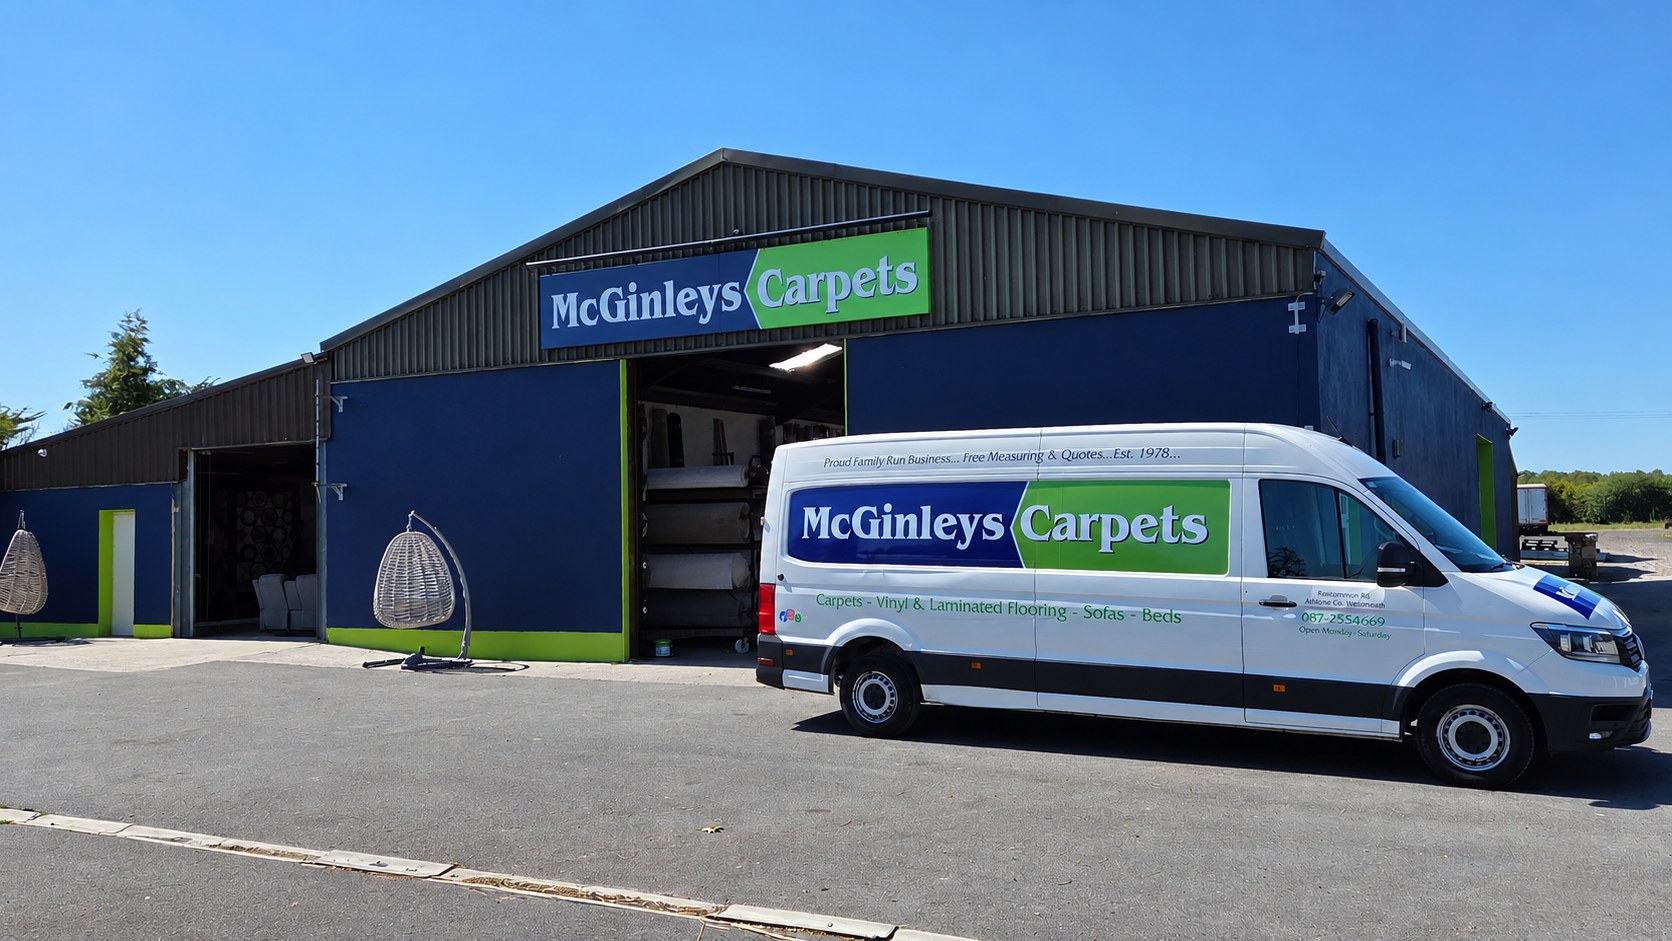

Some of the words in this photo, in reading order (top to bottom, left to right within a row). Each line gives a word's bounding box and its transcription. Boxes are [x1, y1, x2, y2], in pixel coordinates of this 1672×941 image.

[551, 280, 742, 330] McGinleys
[757, 255, 919, 314] Carpets
[823, 457, 852, 469] Proud
[852, 456, 885, 469] Family
[886, 455, 906, 466] Run
[962, 452, 985, 463] Free
[987, 450, 1044, 464] Measuring
[1047, 449, 1057, 461] &
[802, 503, 1004, 550] McGinleys
[1020, 504, 1209, 553] Carpets
[816, 593, 863, 609] Carpets
[876, 596, 908, 613] Vinyl
[912, 597, 925, 611] &
[929, 598, 1003, 615] Laminated
[1007, 601, 1067, 622] Flooring
[1083, 604, 1125, 621] Sofas
[1142, 607, 1182, 624] Beds
[1301, 612, 1386, 627] 087-2554669
[1298, 625, 1321, 635] Open
[1321, 627, 1353, 638] Monday
[1357, 629, 1392, 641] Saturday
